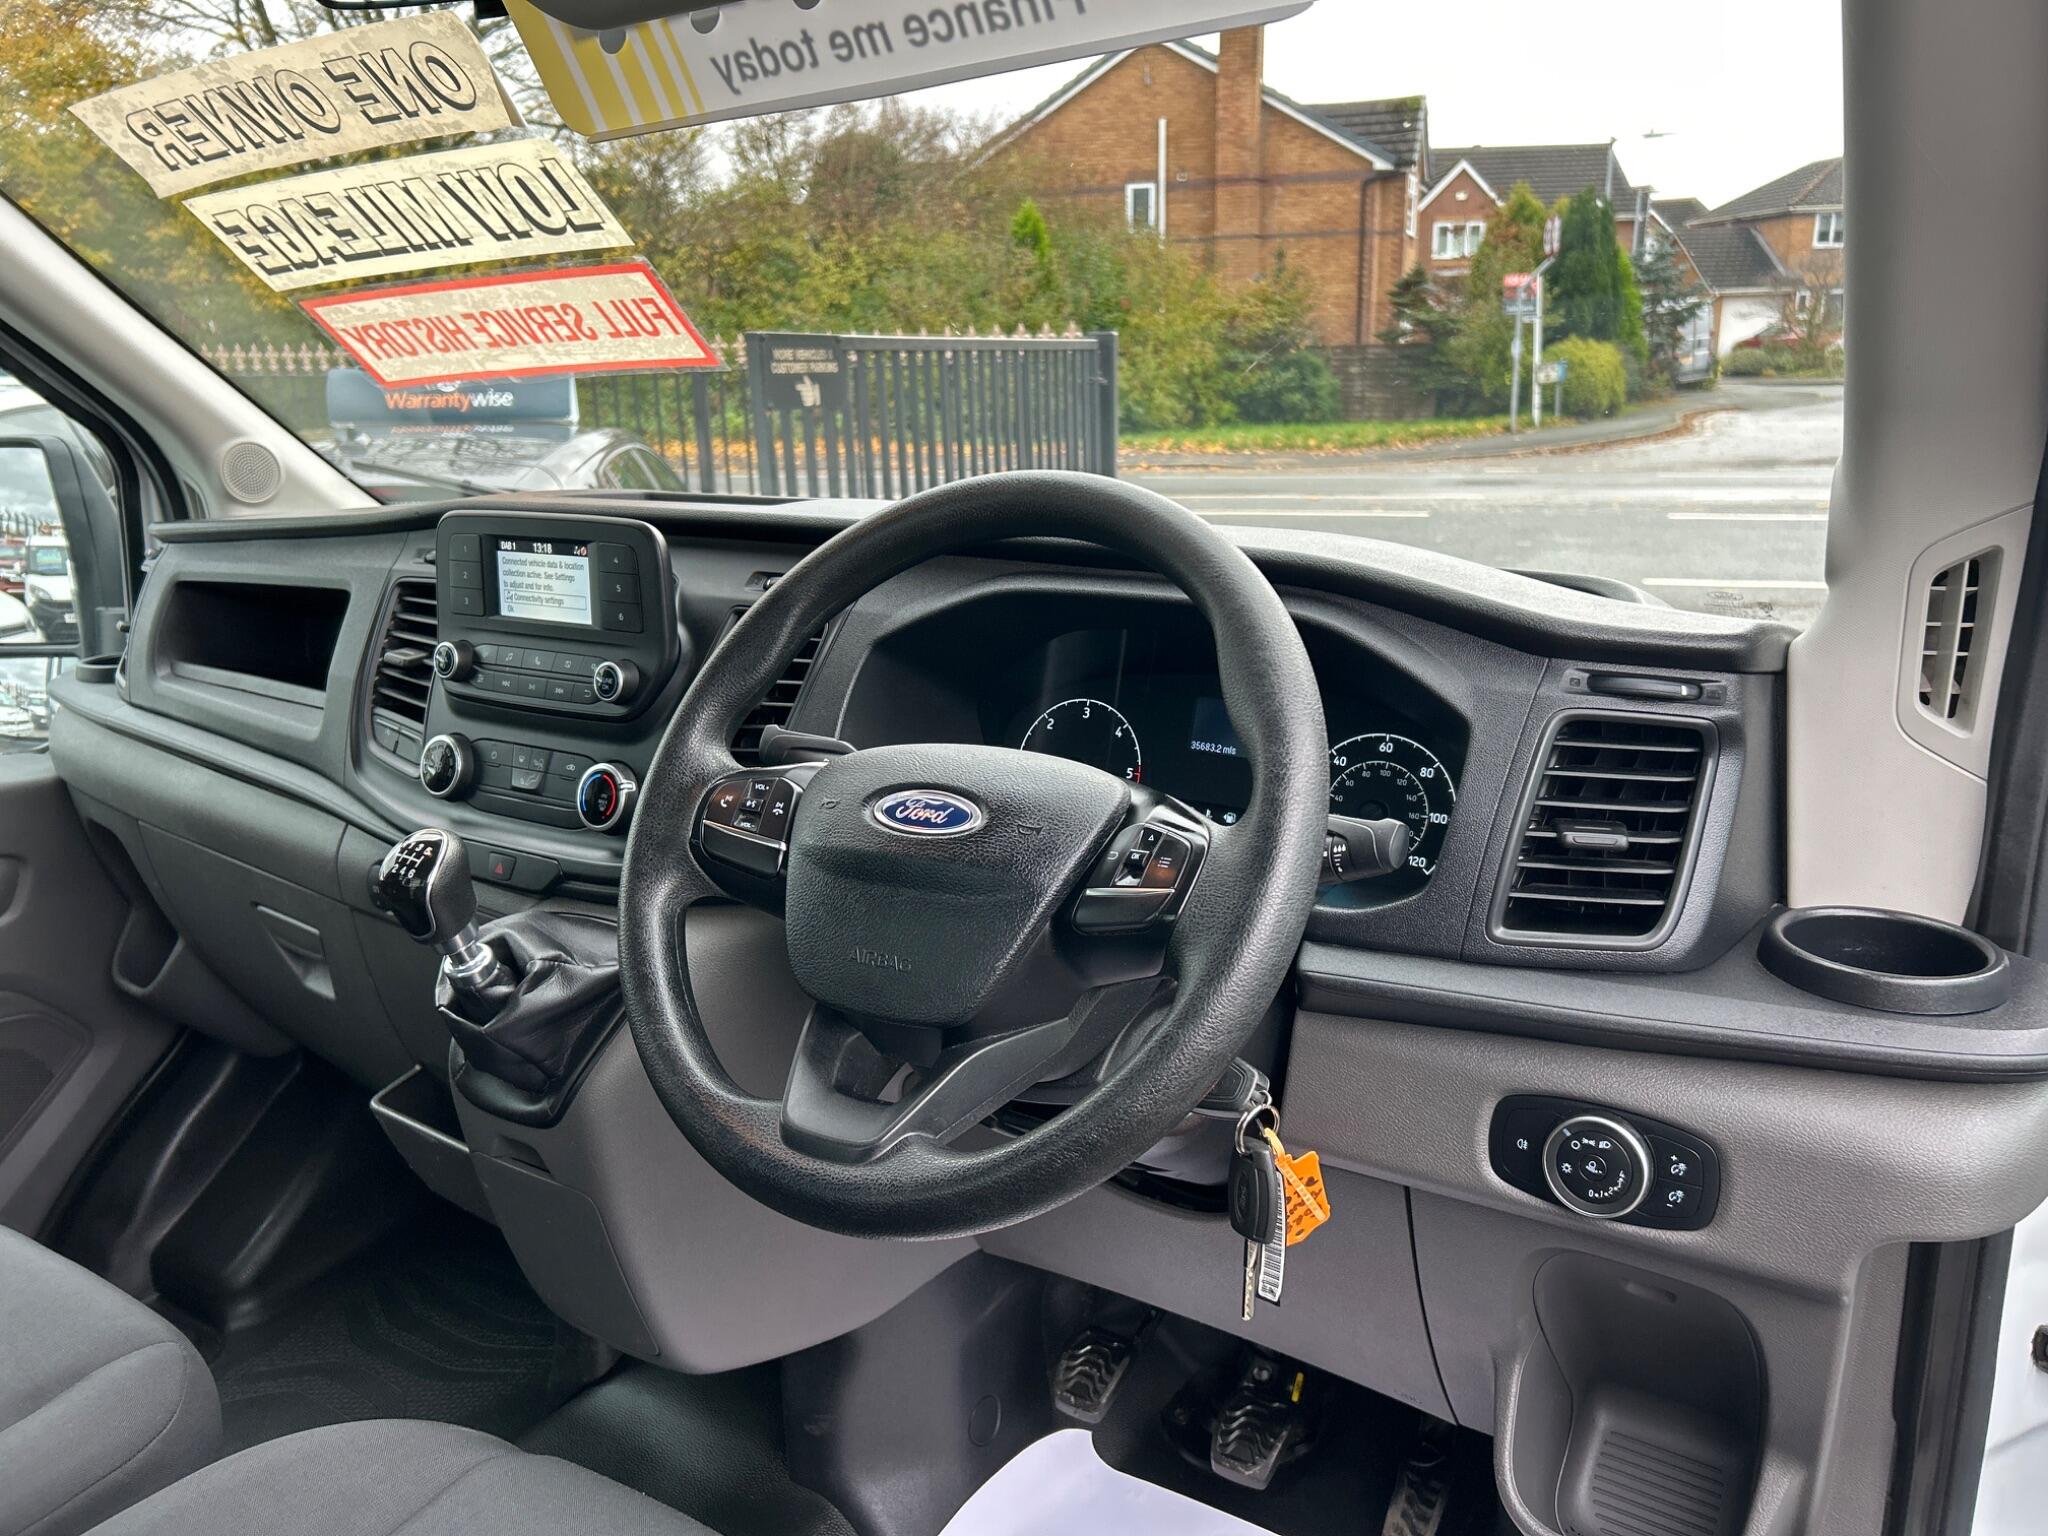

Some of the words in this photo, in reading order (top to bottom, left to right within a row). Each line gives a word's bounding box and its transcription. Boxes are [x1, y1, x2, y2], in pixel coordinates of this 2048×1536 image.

[1046, 718, 1055, 730] 2
[1082, 708, 1090, 718] 3
[1114, 726, 1122, 738] 4
[1126, 768, 1134, 779] 5
[1190, 740, 1222, 754] 35683.2
[1379, 742, 1394, 753] 60
[1333, 756, 1347, 766] 40
[1420, 768, 1434, 779] 80
[1397, 778, 1407, 786] 120
[1334, 794, 1344, 802] 40
[1406, 794, 1417, 802] 140
[895, 797, 956, 824] Ford
[1408, 812, 1420, 820] 160
[1429, 812, 1448, 824] 100
[415, 844, 424, 852] 3
[1408, 856, 1426, 868] 120
[391, 864, 399, 873] 2
[400, 866, 406, 875] 4
[408, 868, 416, 878] 6
